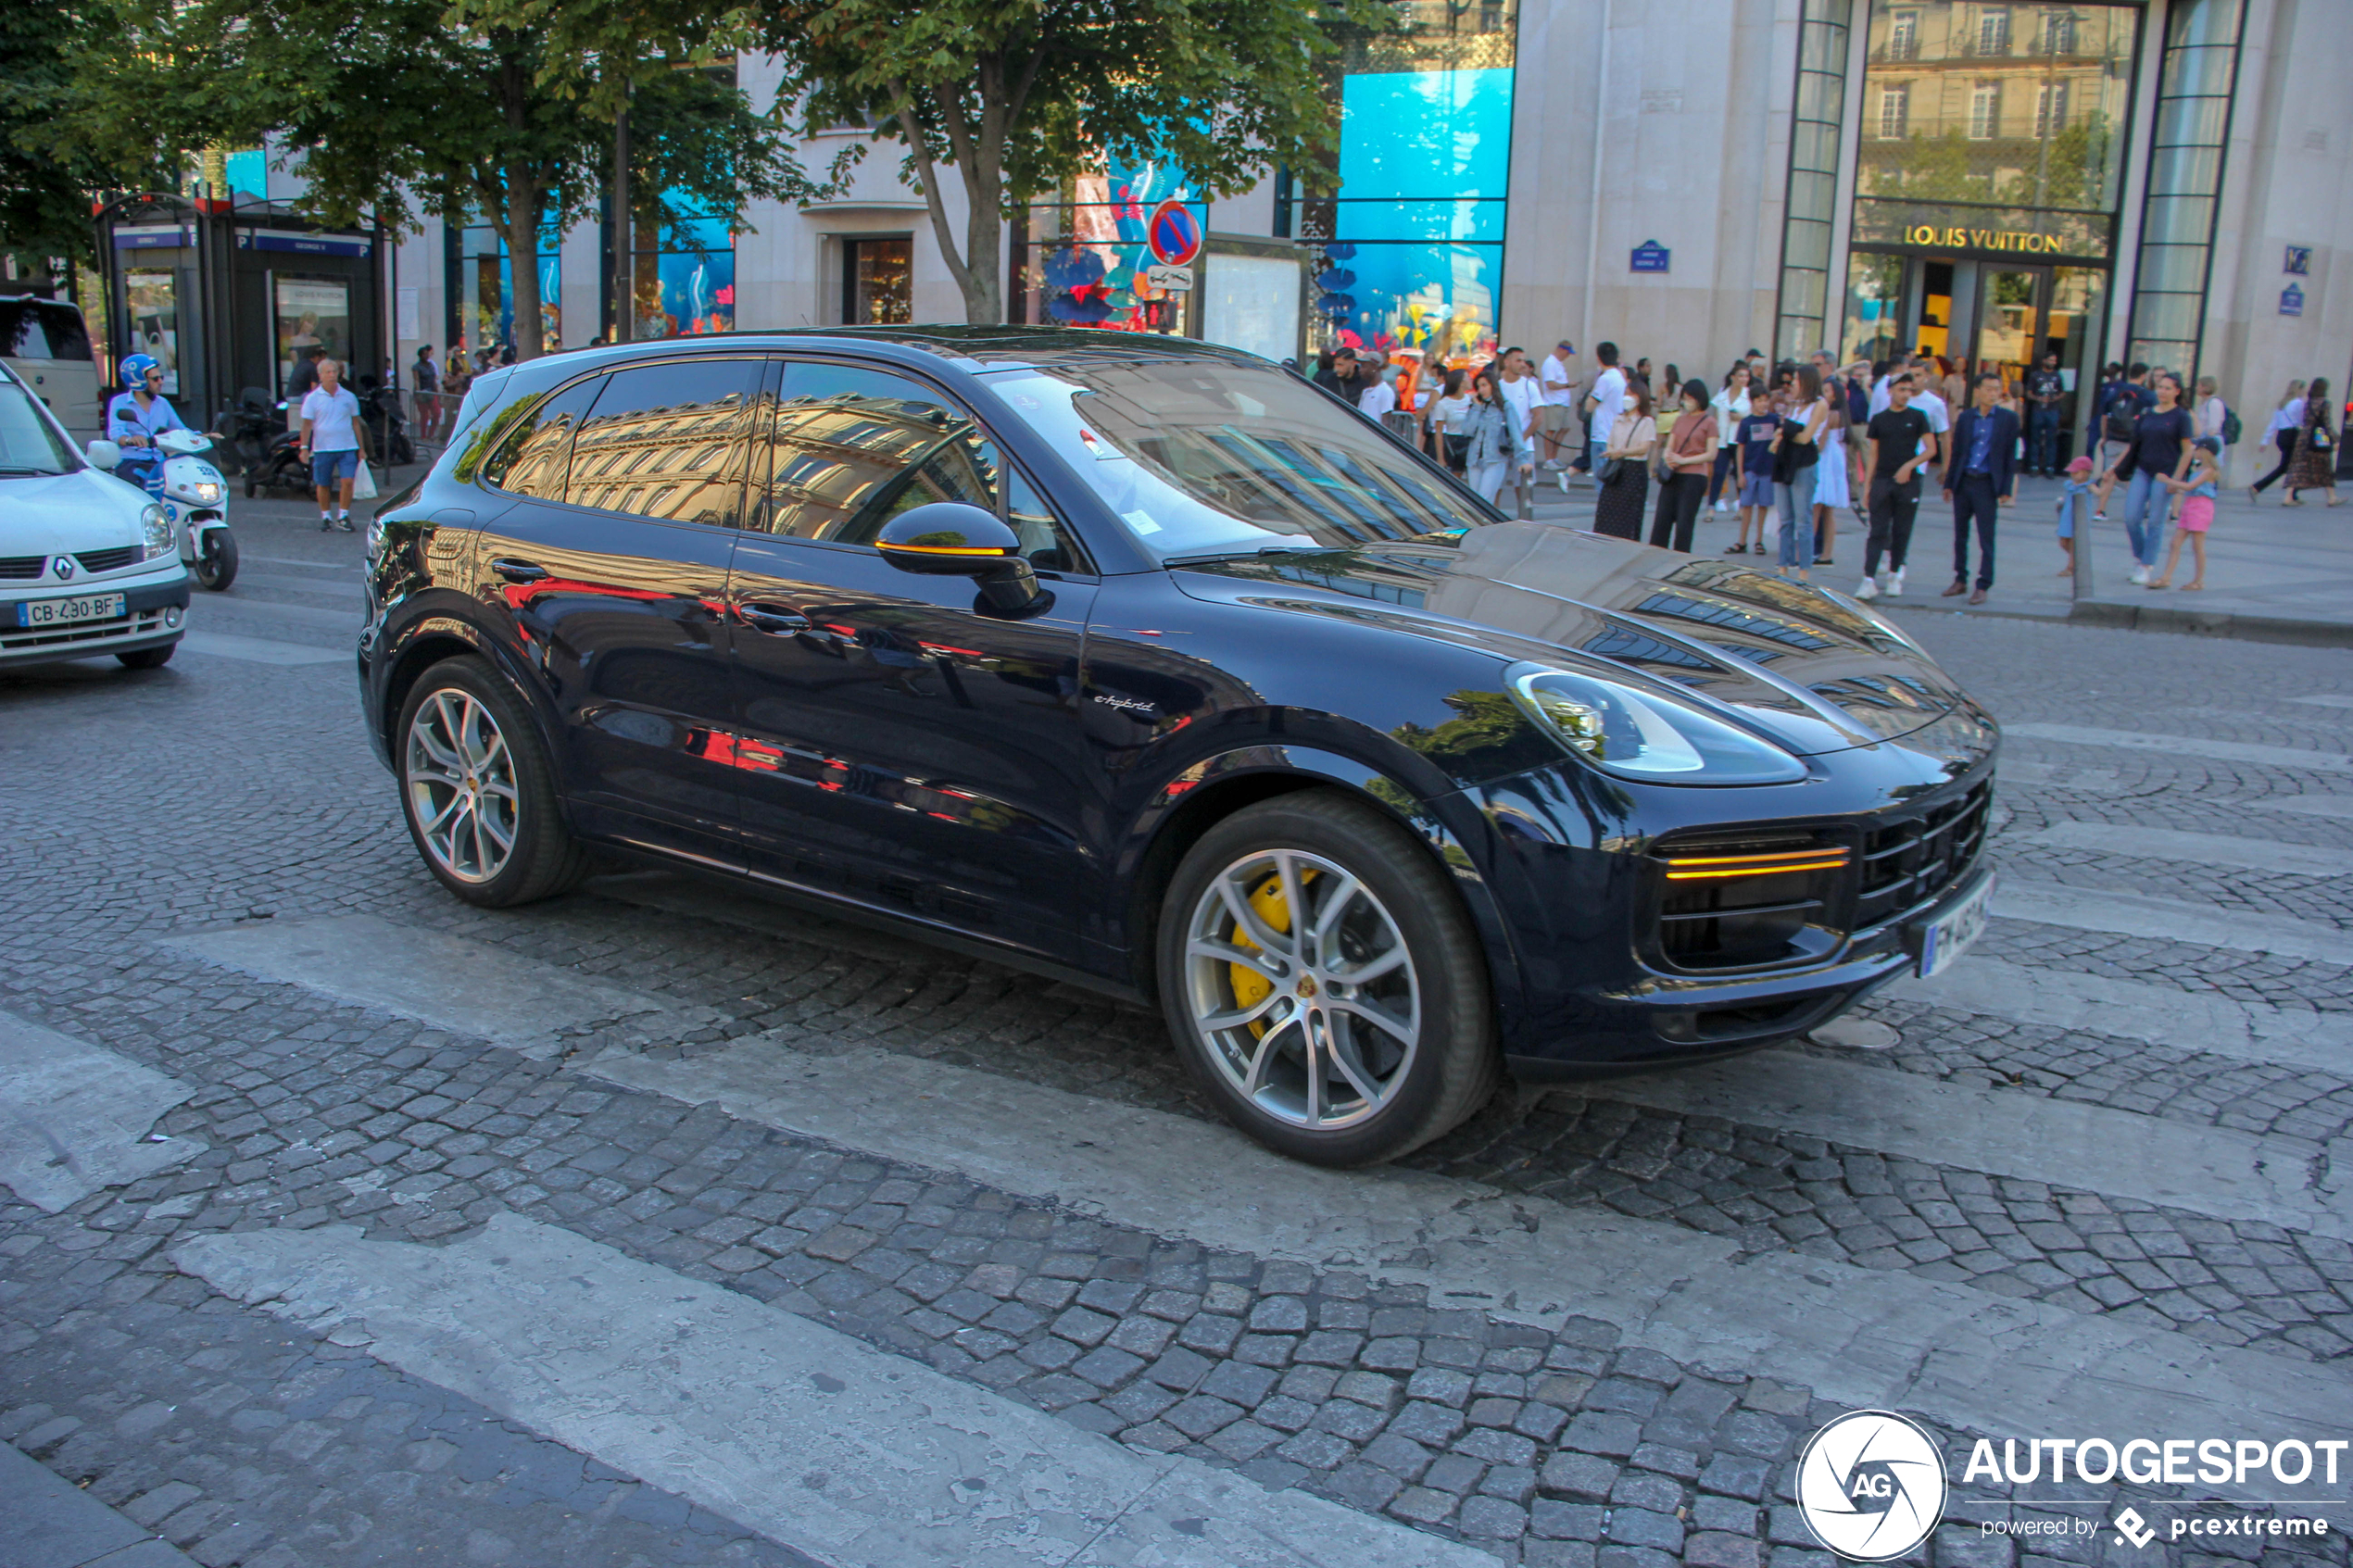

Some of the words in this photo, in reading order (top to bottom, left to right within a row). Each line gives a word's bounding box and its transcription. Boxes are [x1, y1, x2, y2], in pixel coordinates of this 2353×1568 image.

[237, 235, 247, 248] P
[1904, 225, 1968, 248] LOUIS
[1969, 229, 2063, 253] VUITTON
[359, 245, 369, 257] P
